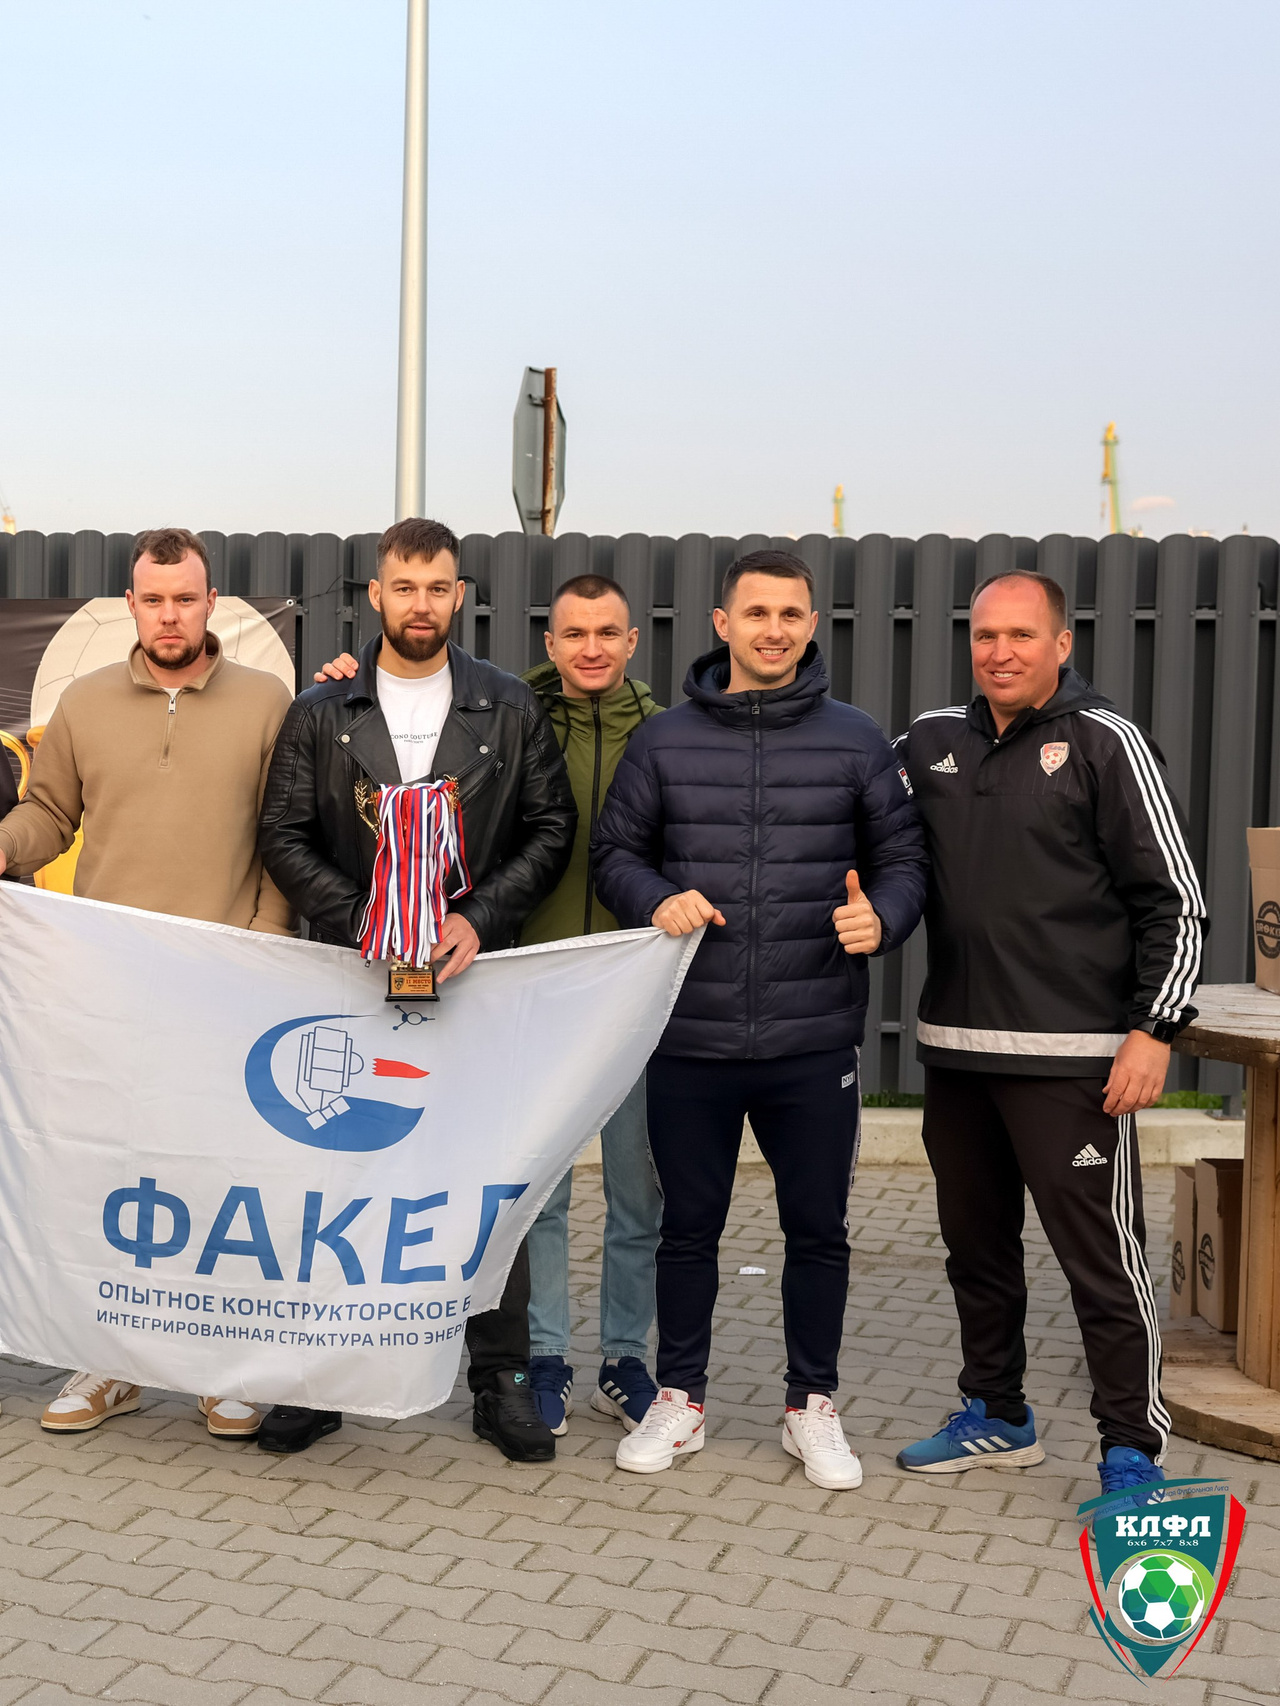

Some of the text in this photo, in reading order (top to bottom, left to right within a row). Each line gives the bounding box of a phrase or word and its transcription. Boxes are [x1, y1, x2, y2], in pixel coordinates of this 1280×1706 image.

[930, 764, 958, 774] adidas
[1072, 1157, 1108, 1167] adidas
[103, 1176, 530, 1285] ФАКЕЛ
[98, 1280, 215, 1313] ОПЫТНОЕ
[222, 1296, 458, 1322] КОНСТРУКТОРСКОЕ
[96, 1309, 467, 1347] ИНТЕГРИРОВАННАЯ СТРУКТУРА НПО ЭНЕРГ
